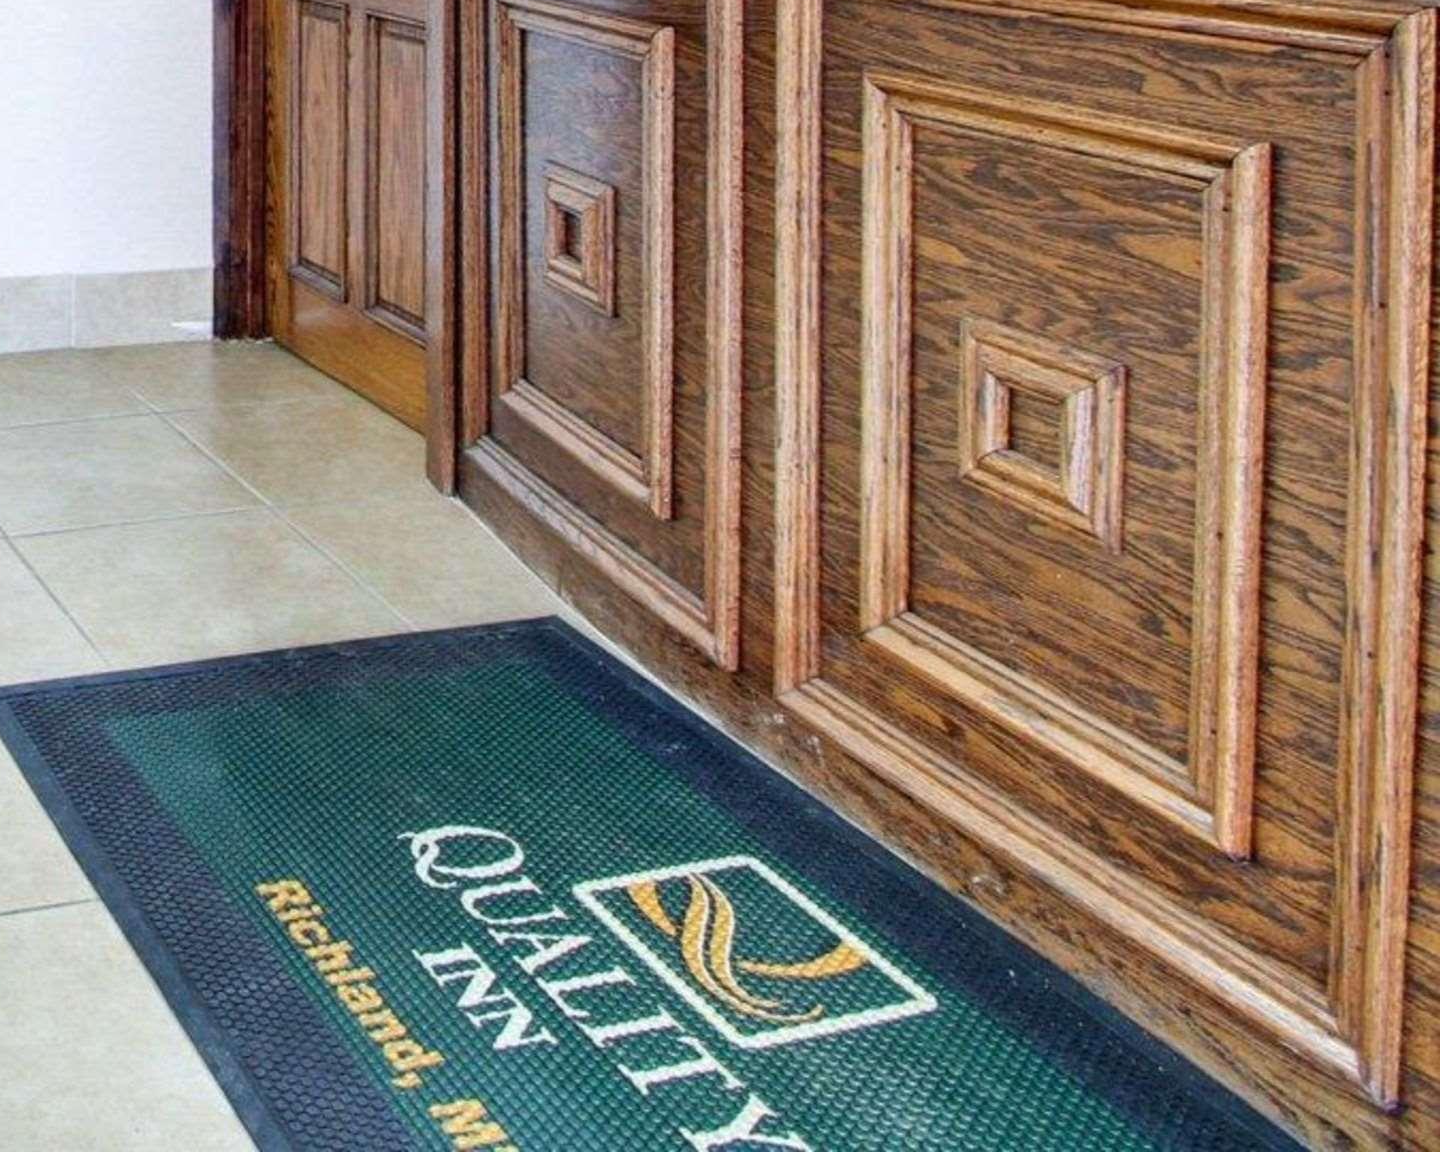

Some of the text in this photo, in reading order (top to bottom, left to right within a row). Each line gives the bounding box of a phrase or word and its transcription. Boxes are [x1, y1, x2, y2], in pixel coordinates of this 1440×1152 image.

[256, 879, 520, 1152] Richland, M
[397, 825, 812, 1152] QUALITY
[413, 942, 557, 1049] INN
